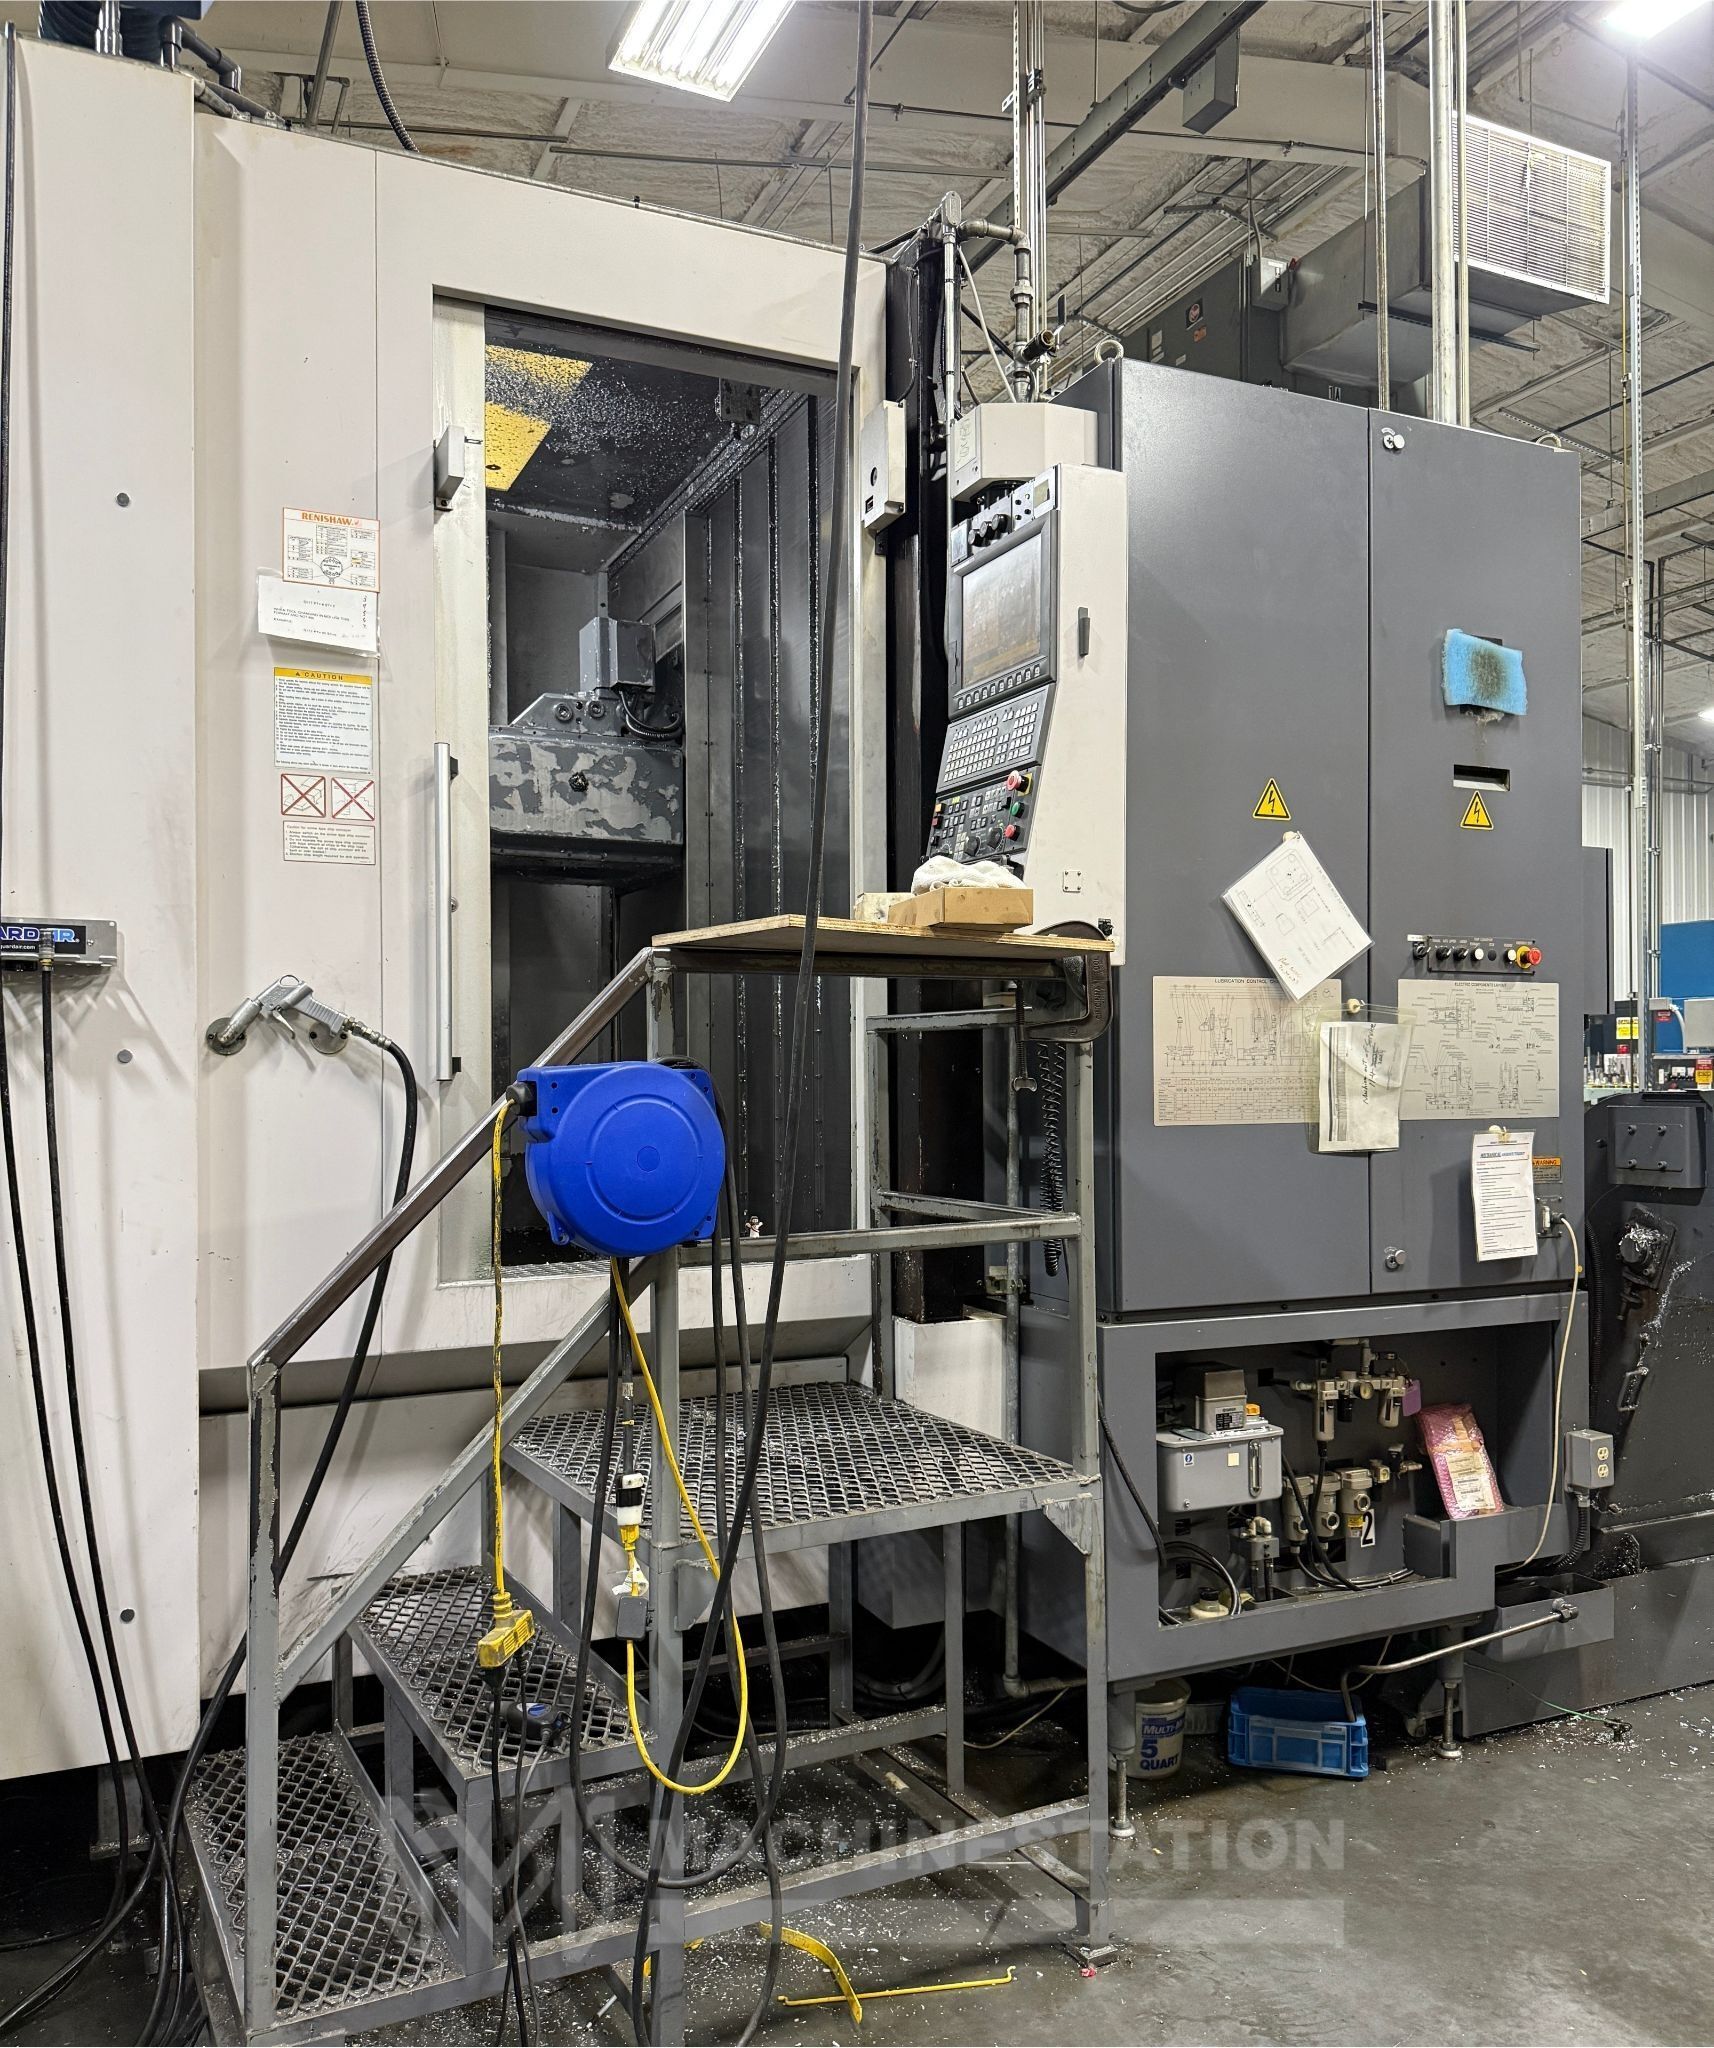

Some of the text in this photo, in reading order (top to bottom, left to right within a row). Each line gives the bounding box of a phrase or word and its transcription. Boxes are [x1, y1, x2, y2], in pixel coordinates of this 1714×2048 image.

[301, 512, 352, 526] RENISHAW
[304, 672, 343, 681] CAUTION
[1362, 1511, 1373, 1545] 2
[1140, 1738, 1158, 1759] 5
